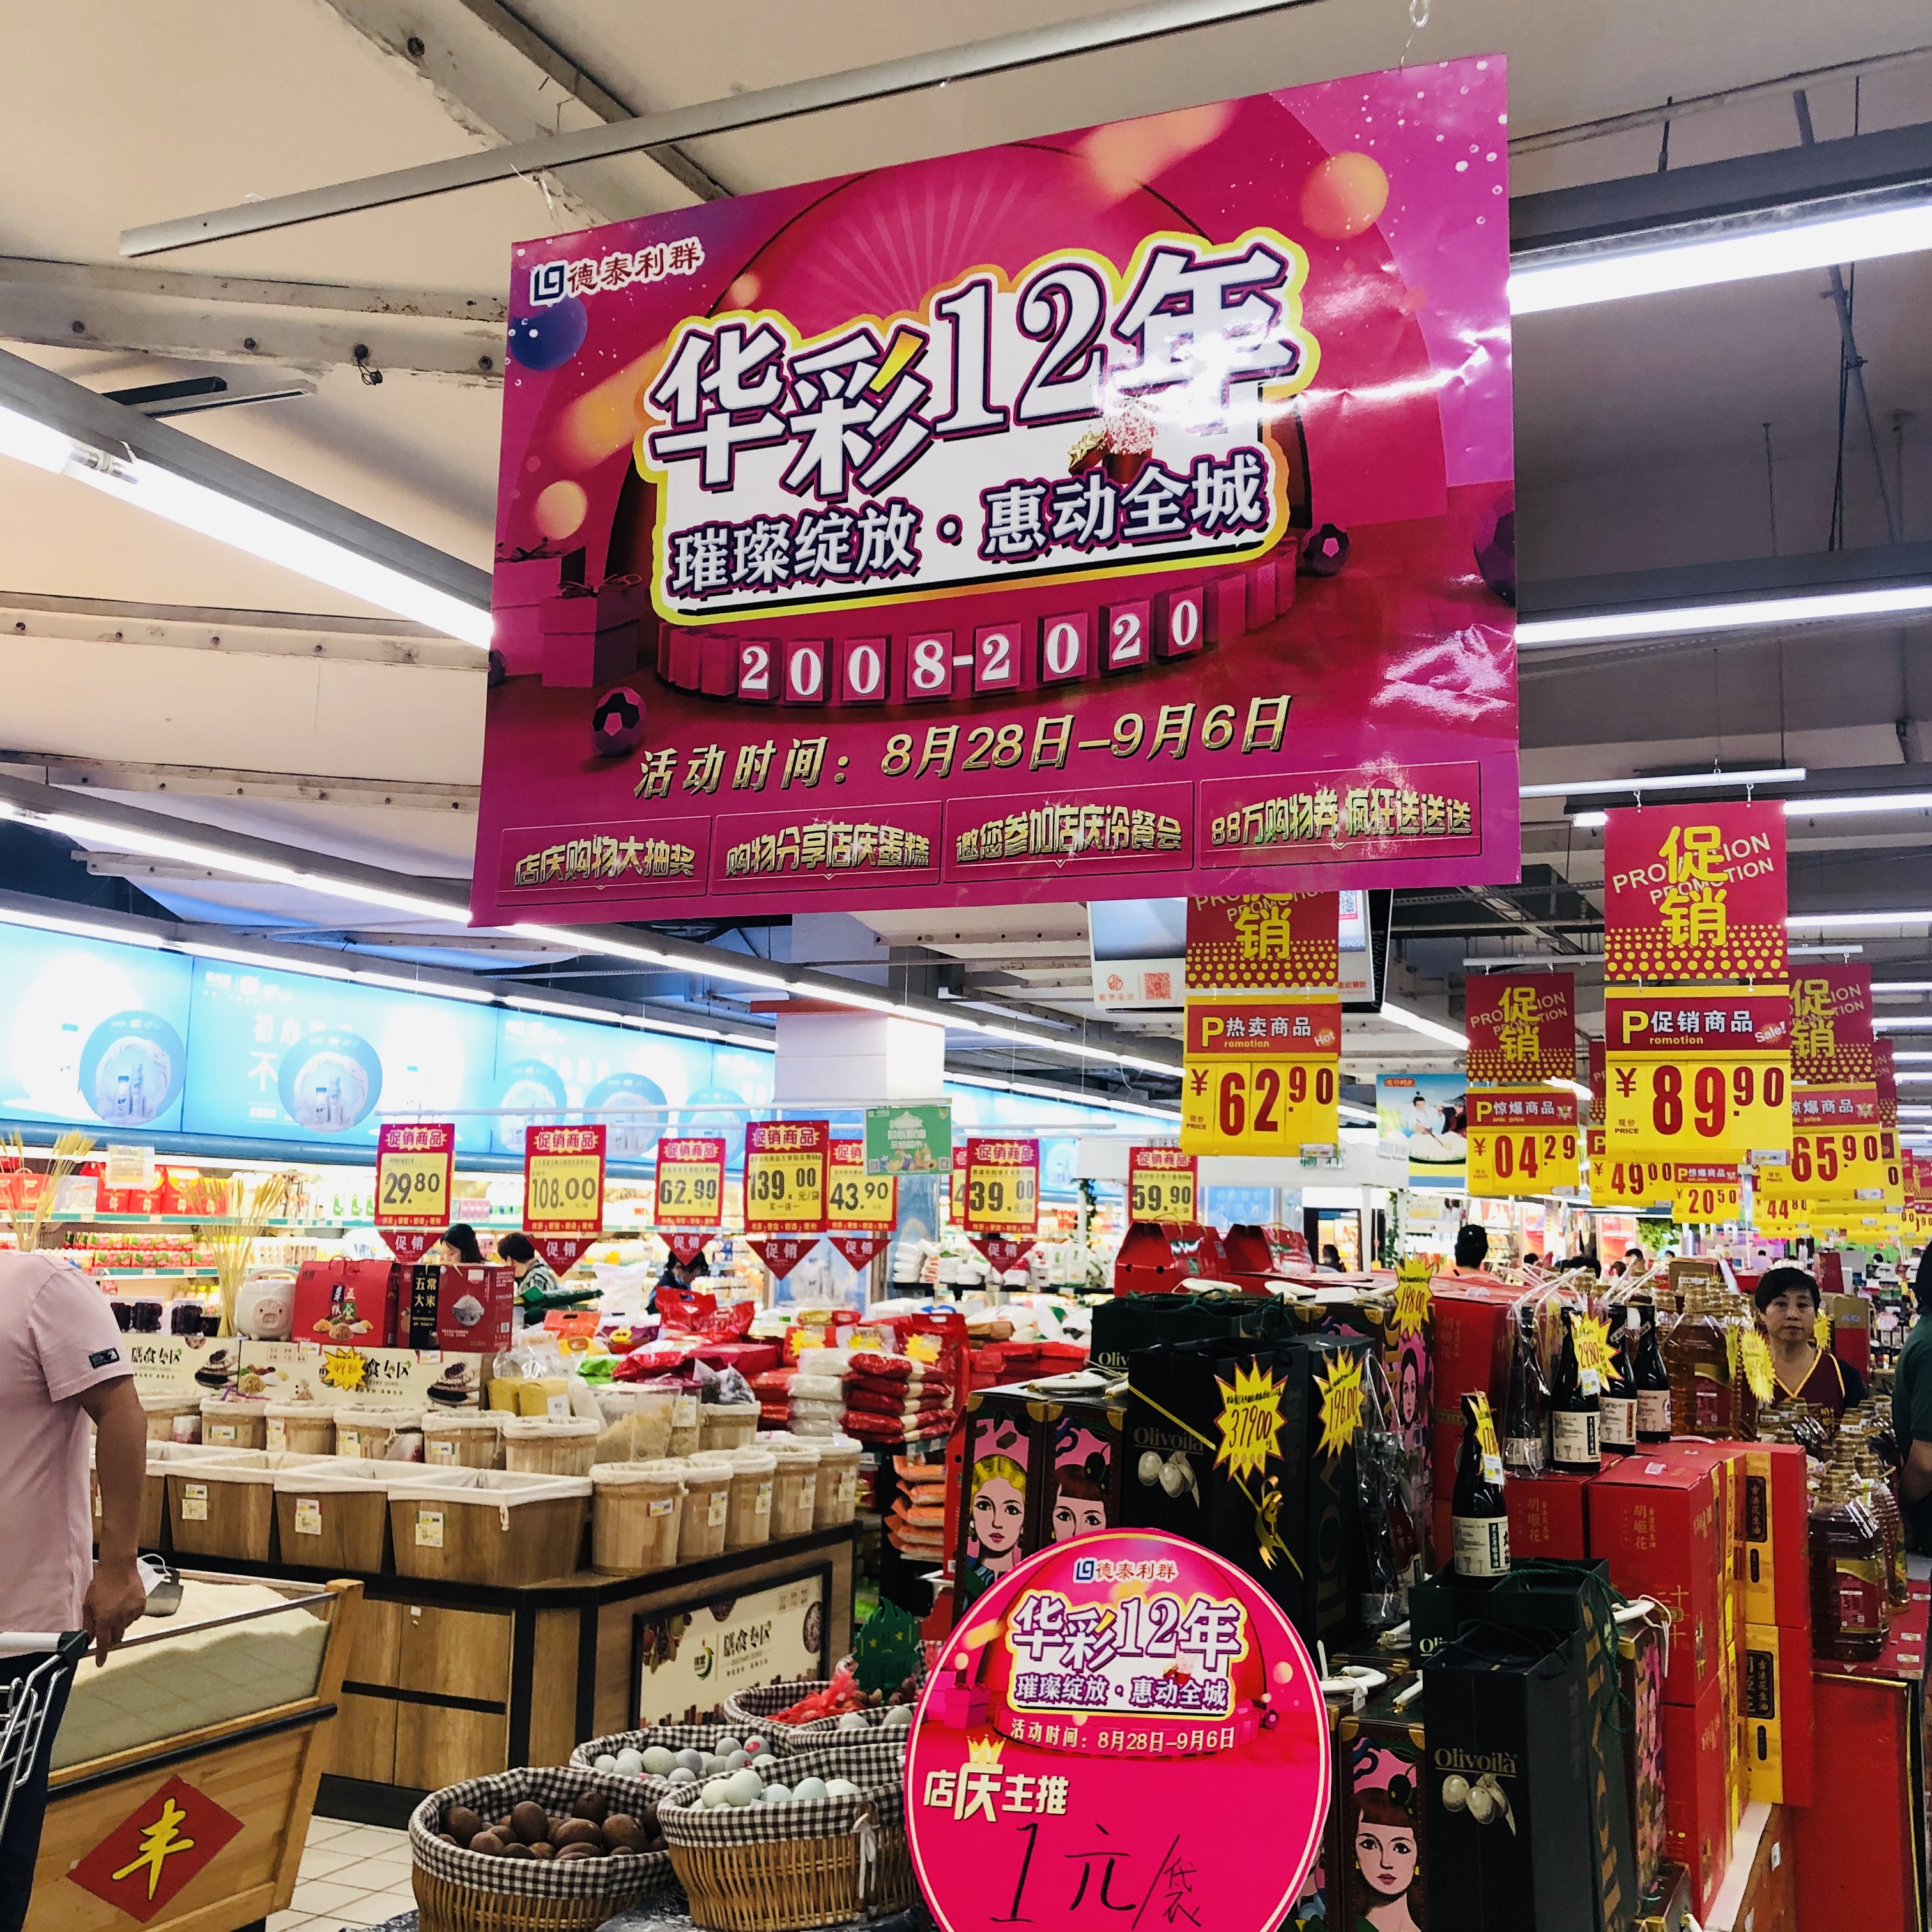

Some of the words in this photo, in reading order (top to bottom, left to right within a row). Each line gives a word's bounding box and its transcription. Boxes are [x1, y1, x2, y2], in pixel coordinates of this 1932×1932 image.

[567, 244, 702, 293] 德泰利群
[648, 245, 1301, 501] 华彩12年
[671, 451, 1266, 594] 璀璨绽放·惠动全城
[740, 599, 1199, 696] 2008-2020
[1211, 790, 1339, 846] 88万购物券
[1344, 787, 1473, 838] 疯狂送送送
[726, 822, 931, 877] 购物分享店庆蛋糕
[954, 804, 1183, 864] 邀您参加店庆冷餐会
[514, 835, 696, 886] 店庆购物大抽奖
[1659, 825, 1728, 946] 促销
[1226, 1016, 1312, 1038] 热卖商品
[1498, 986, 1540, 1062] 促销
[1651, 1010, 1753, 1034] 促销商品
[1754, 1021, 1787, 1044] Sale!
[1314, 1030, 1336, 1048] Hot
[1219, 1066, 1333, 1137] 62.90
[1494, 1101, 1555, 1116] 惊爆商品
[1652, 1065, 1784, 1137] 89.90
[389, 1130, 442, 1146] 促销商品
[538, 1132, 594, 1148] 促销商品
[667, 1144, 714, 1158] 促销商品
[755, 1129, 815, 1146] 促销商品
[979, 1145, 1032, 1160] 促销商品
[1494, 1135, 1576, 1179] 04.29
[1791, 1135, 1878, 1182] 65.90
[383, 1172, 440, 1204] 29.80
[532, 1177, 596, 1209] 108.00
[660, 1179, 717, 1205] 62.90
[749, 1167, 816, 1200] 139.00
[829, 1181, 889, 1211] 43.90
[1133, 1184, 1191, 1211] 59.90
[546, 1241, 576, 1257] 促销
[765, 1242, 798, 1259] 促销
[415, 1276, 437, 1291] 五常
[414, 1295, 436, 1308] 大米
[1633, 1504, 1648, 1551] 胡姬花
[1096, 1560, 1177, 1582] 德泰利群
[1011, 1594, 1245, 1673] 华彩12年
[1015, 1675, 1227, 1708] 璀璨绽放·惠动全城
[1434, 1747, 1517, 1775] Olivoilà
[923, 1762, 1069, 1822] 店庆主推
